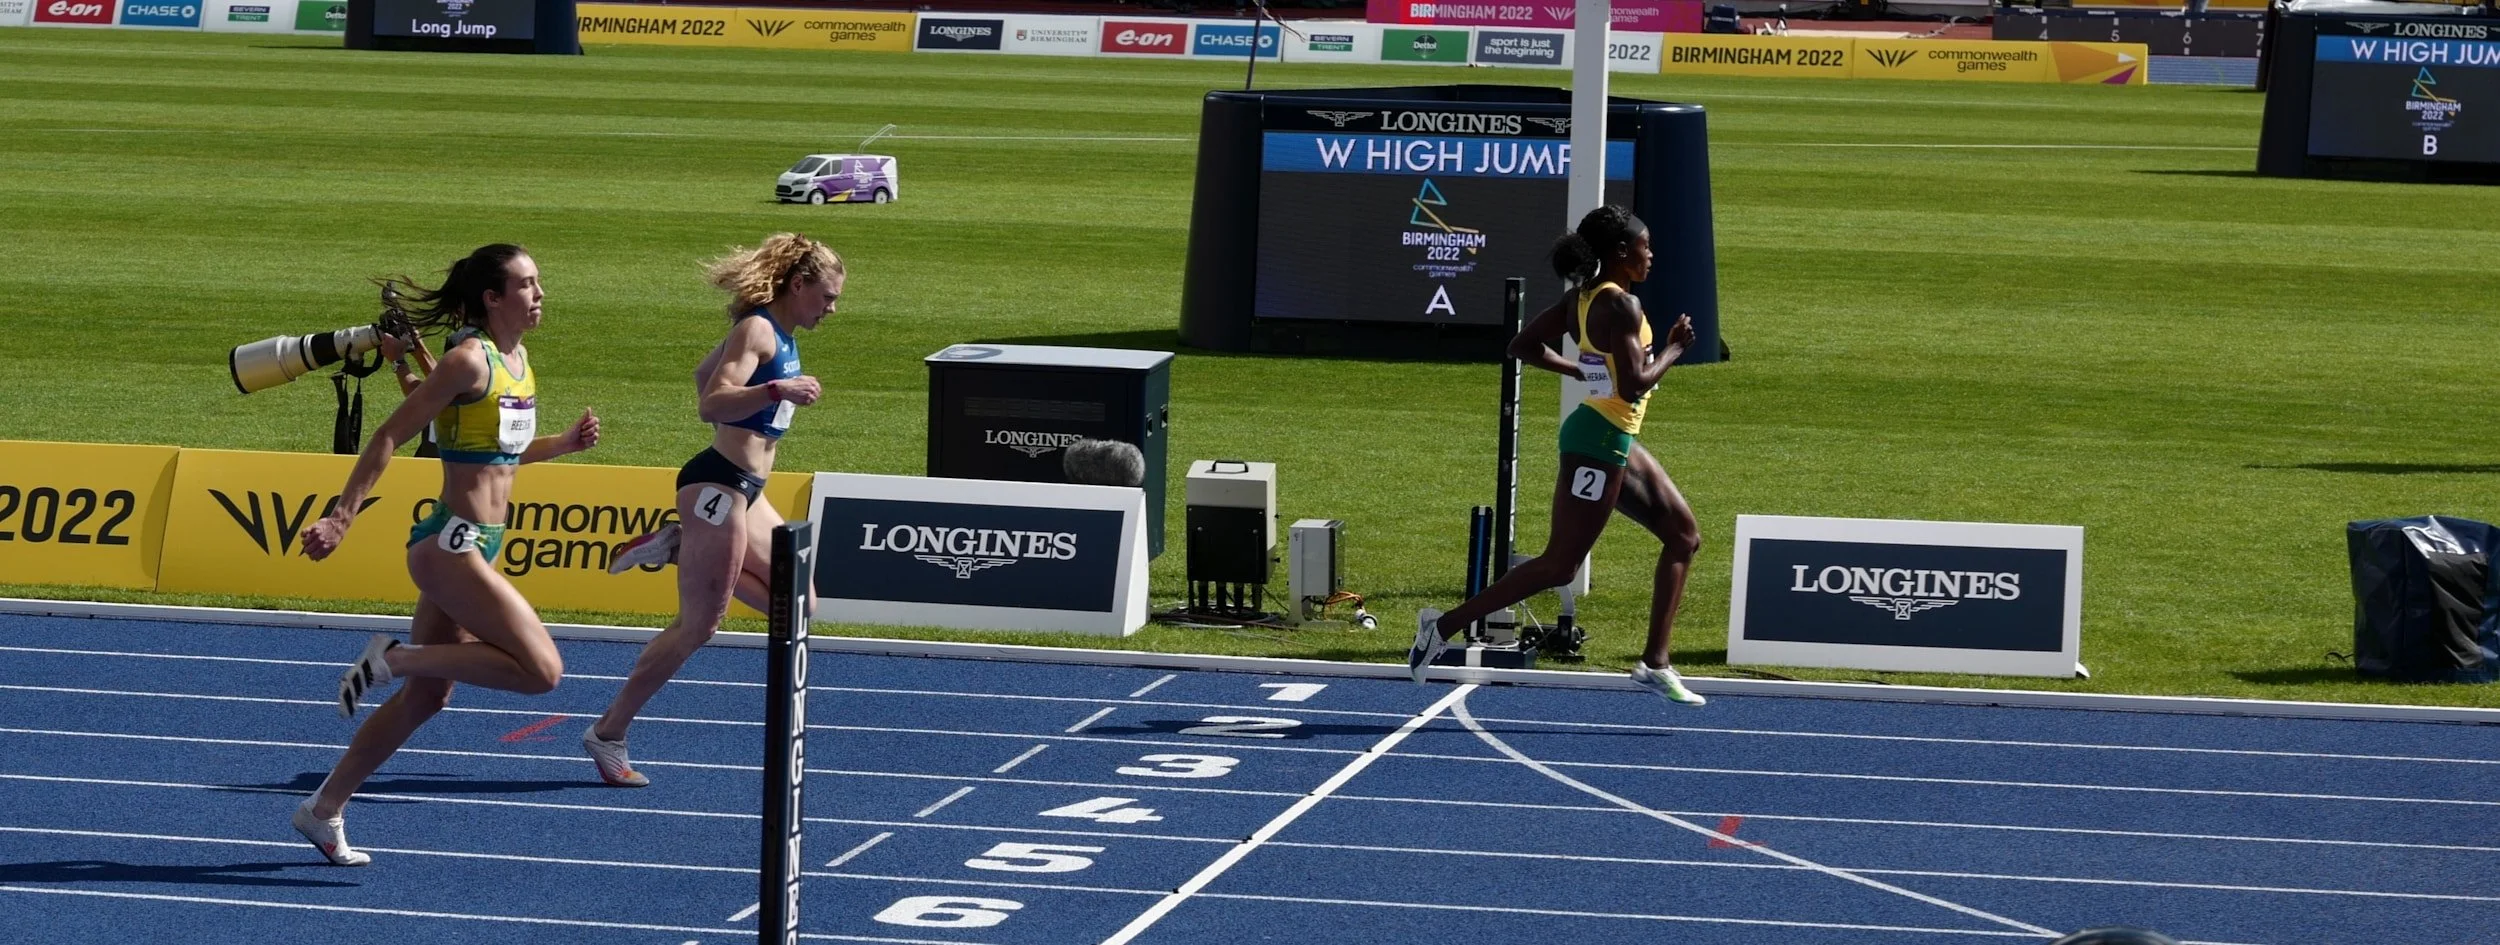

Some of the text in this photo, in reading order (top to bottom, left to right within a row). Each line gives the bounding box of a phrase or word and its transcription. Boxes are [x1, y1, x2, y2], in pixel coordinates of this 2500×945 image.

[127, 5, 179, 16] CHASE
[1410, 4, 1533, 20] BIRMINGHAM 2022
[412, 19, 497, 38] Long Jump
[578, 16, 725, 36] IRMINGHAM 2022
[804, 20, 906, 32] commonwealth
[930, 26, 992, 36] LONGINES
[2394, 23, 2488, 38] LONGINES
[830, 30, 876, 42] games
[1200, 34, 1254, 46] CHASE
[1490, 38, 1551, 49] sport is just
[2039, 30, 2264, 45] 4 5 6 7
[1413, 41, 1437, 50] Dettol
[1484, 46, 1554, 59] the beginning
[1608, 44, 1651, 61] 2022
[2351, 39, 2500, 65] W HIGH JUM
[1672, 46, 1844, 66] BIRMINGHAM 2022
[1928, 50, 2038, 62] commonwealth
[1957, 60, 2007, 73] games
[2405, 101, 2462, 112] BIRMINGHAM
[2421, 110, 2443, 120] 2022
[1380, 111, 1522, 135] LONGINES
[2423, 135, 2438, 155] B
[1316, 137, 1356, 168] W
[1367, 139, 1463, 172] HIGH
[1402, 232, 1486, 247] BIRMINGHAM
[1427, 246, 1460, 260] 2022
[1425, 284, 1456, 315] A
[1580, 470, 1597, 497] 2
[703, 492, 723, 519] 4
[449, 522, 469, 550] 6
[860, 523, 1077, 560] LONGINES
[1791, 565, 2020, 600] LONGINES
[1259, 683, 1328, 701] 1
[1178, 716, 1302, 738] 2
[1115, 754, 1240, 779] 3
[1038, 797, 1164, 823] 4
[964, 842, 1105, 873] 5
[873, 896, 1025, 928] 6
